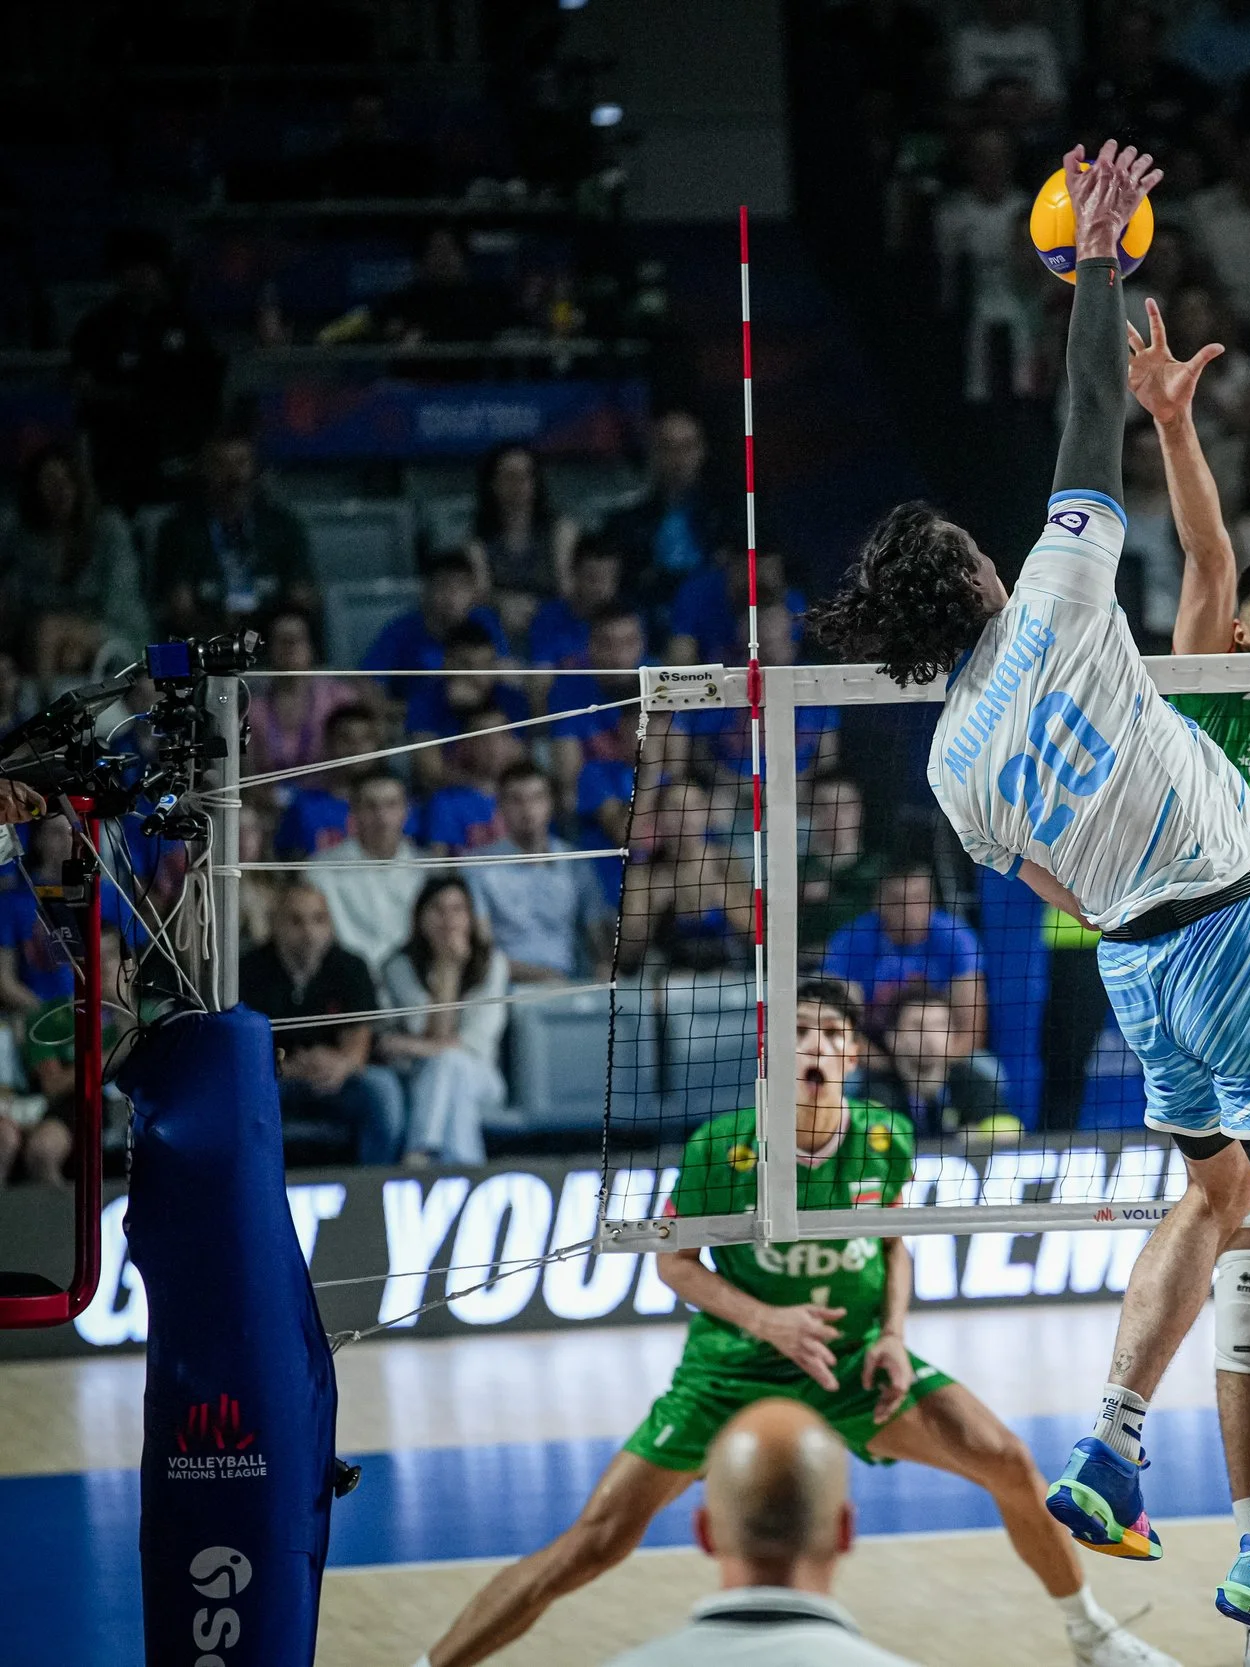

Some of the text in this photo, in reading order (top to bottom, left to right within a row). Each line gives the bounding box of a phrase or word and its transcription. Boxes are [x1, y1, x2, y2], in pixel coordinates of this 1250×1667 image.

[671, 672, 712, 682] Senoh
[998, 691, 1116, 847] 20
[1094, 1207, 1117, 1222] VNL
[168, 1454, 266, 1469] VOLLEYBALL
[168, 1468, 267, 1480] NATIONS LEAGUE
